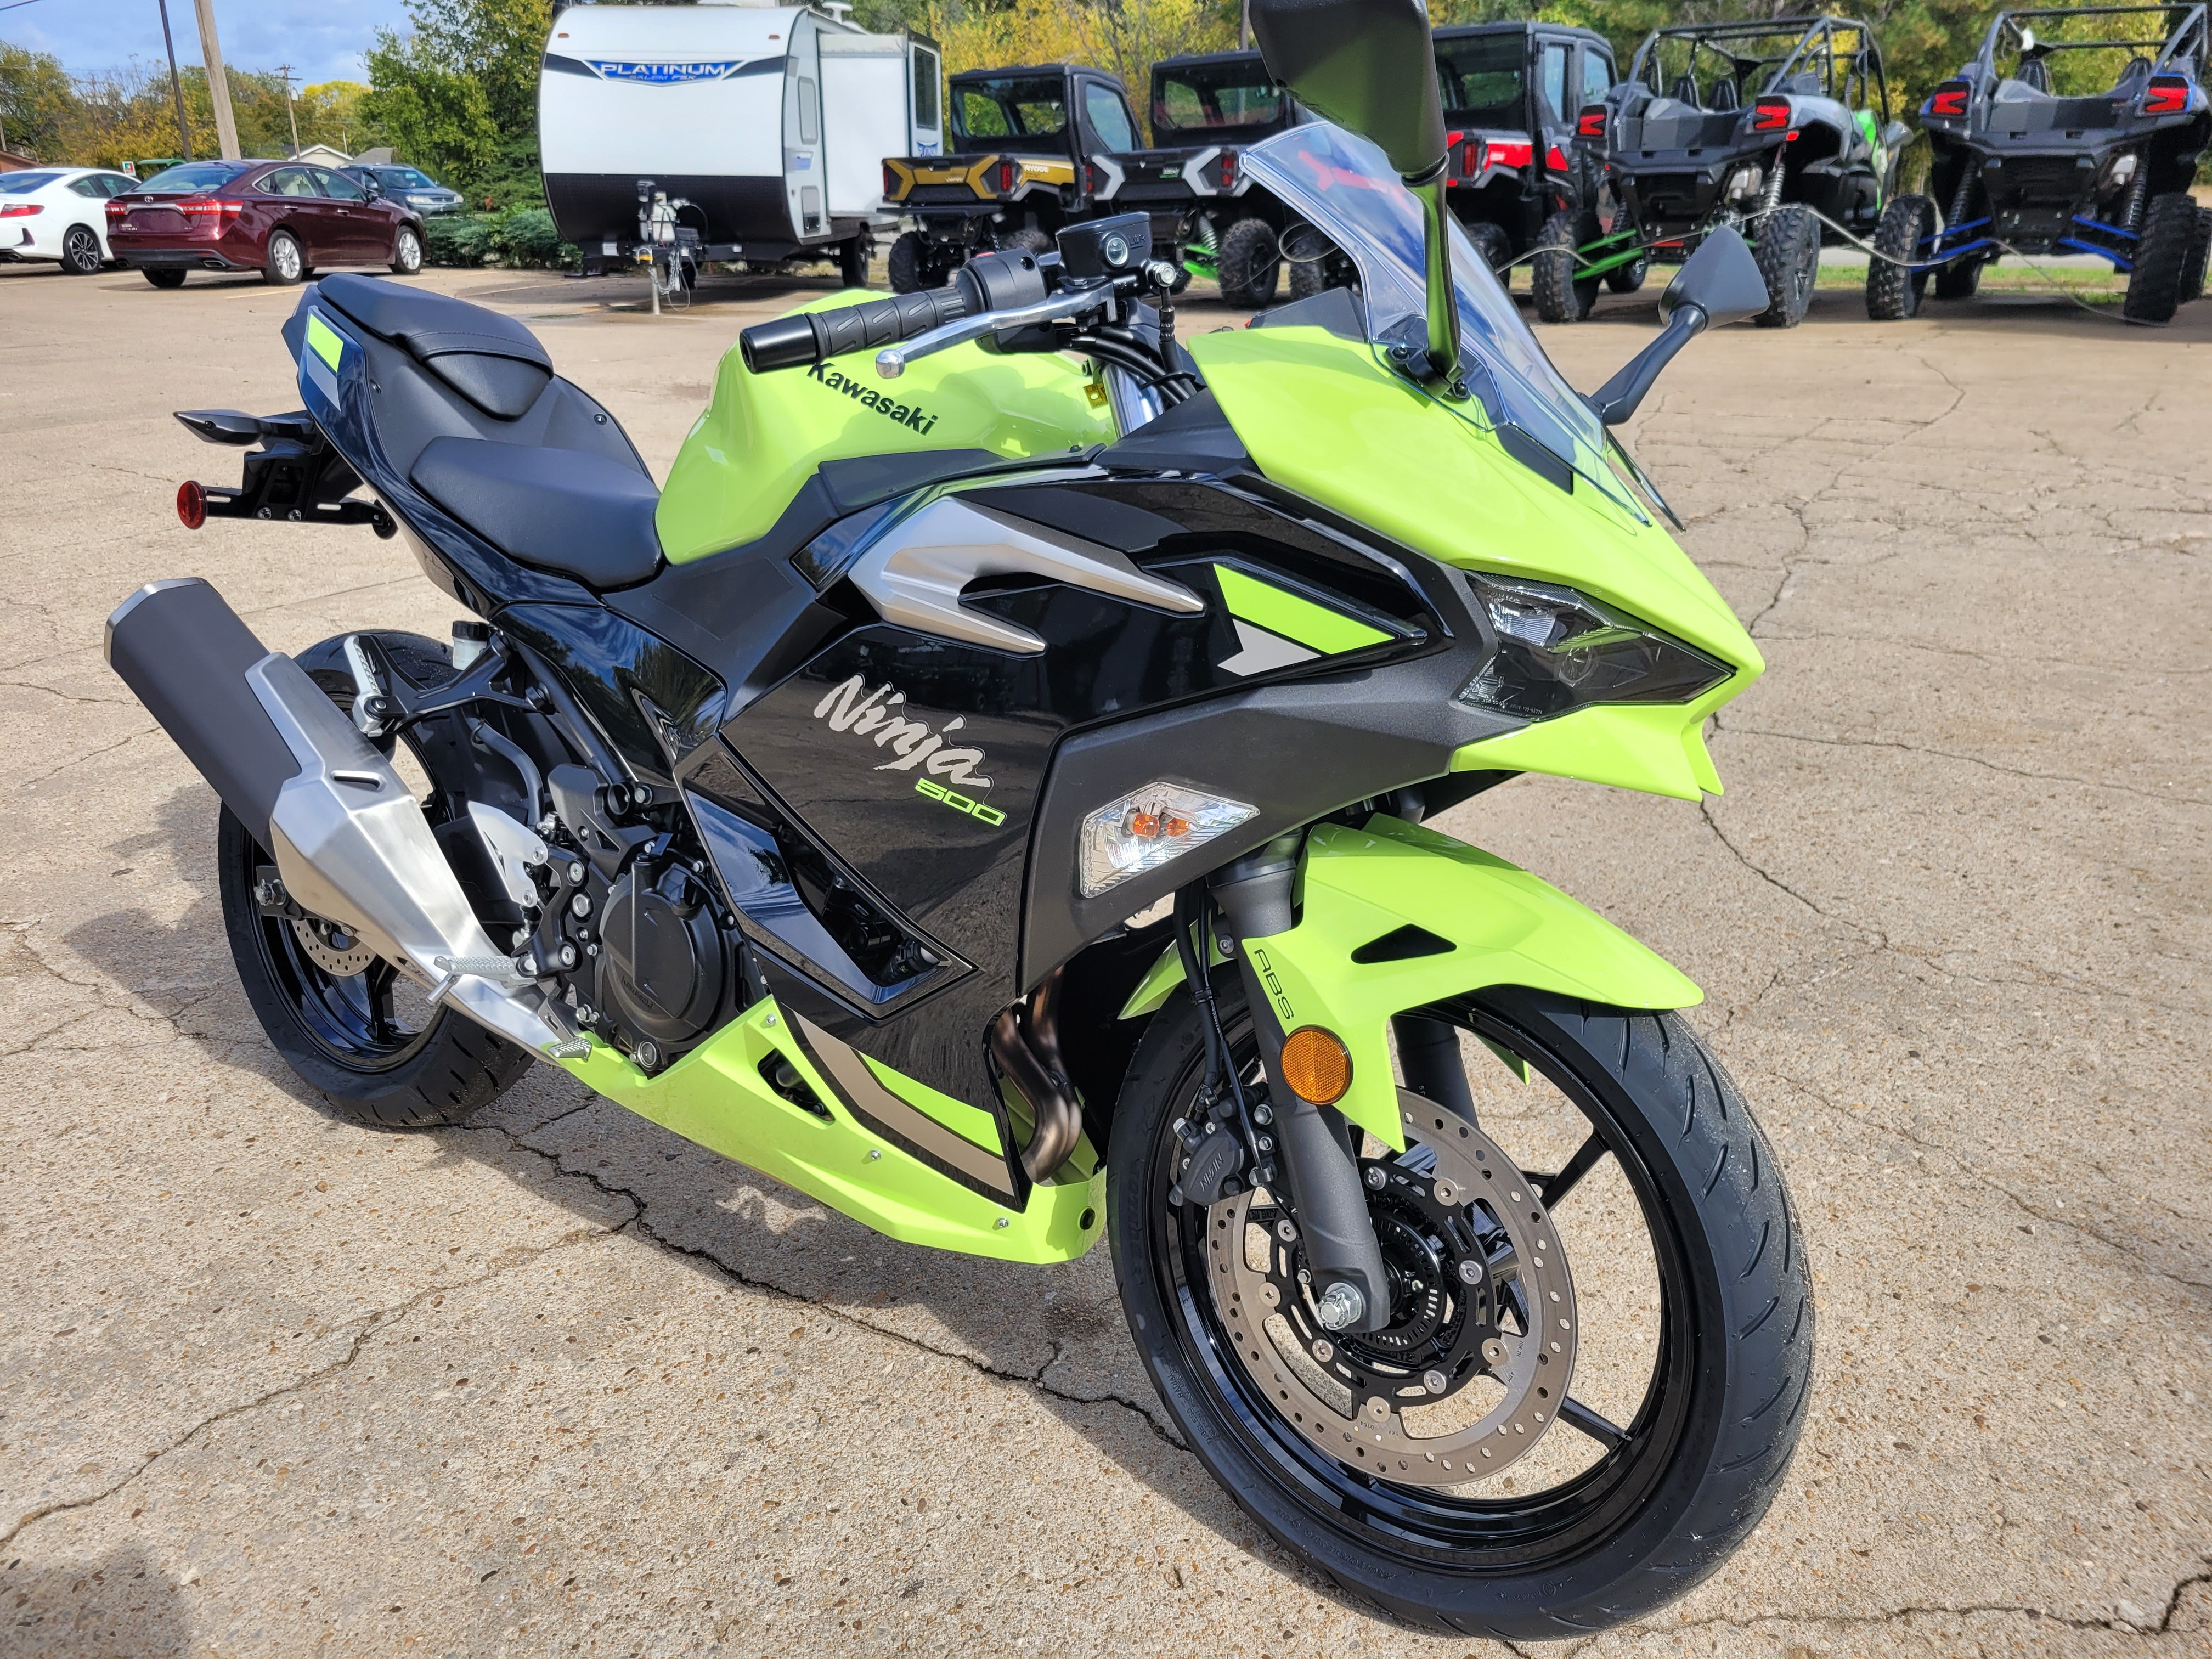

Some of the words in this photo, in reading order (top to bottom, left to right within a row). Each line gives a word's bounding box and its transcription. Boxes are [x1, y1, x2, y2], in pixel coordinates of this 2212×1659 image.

[601, 64, 725, 75] PLATINUM
[806, 362, 939, 436] Kawasaki
[814, 674, 990, 787] Ninja
[915, 777, 1006, 826] 500
[1254, 949, 1294, 1019] ABS
[1200, 1152, 1224, 1192] NISSIN
[1167, 1371, 1184, 1399] RADIAL
[1186, 1407, 1214, 1446] TUBELESS
